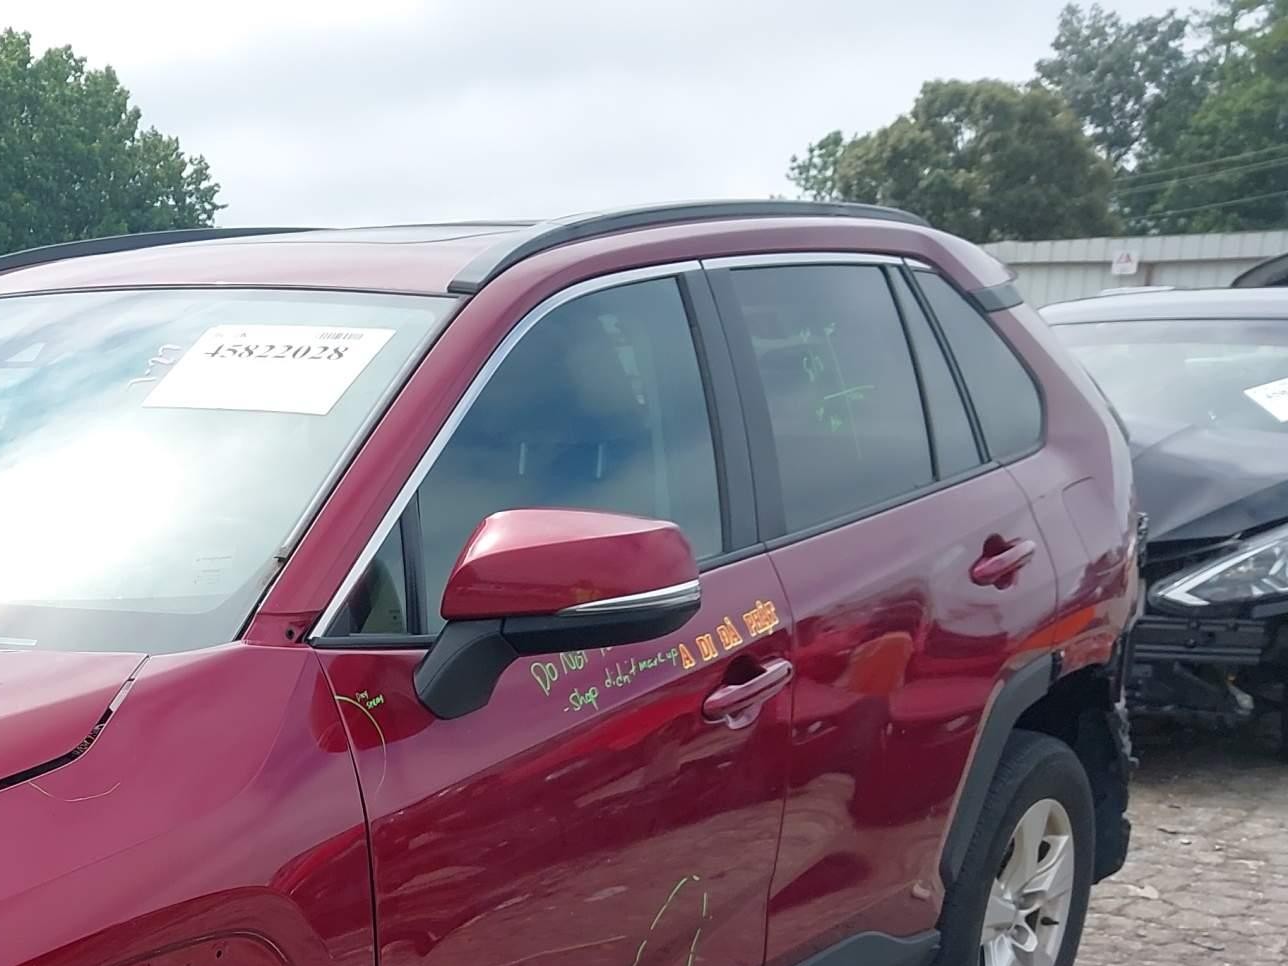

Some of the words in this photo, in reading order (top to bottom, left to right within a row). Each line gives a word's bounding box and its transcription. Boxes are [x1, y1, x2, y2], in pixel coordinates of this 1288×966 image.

[203, 344, 349, 360] 45822028
[679, 643, 696, 669] A
[695, 633, 719, 661] DI
